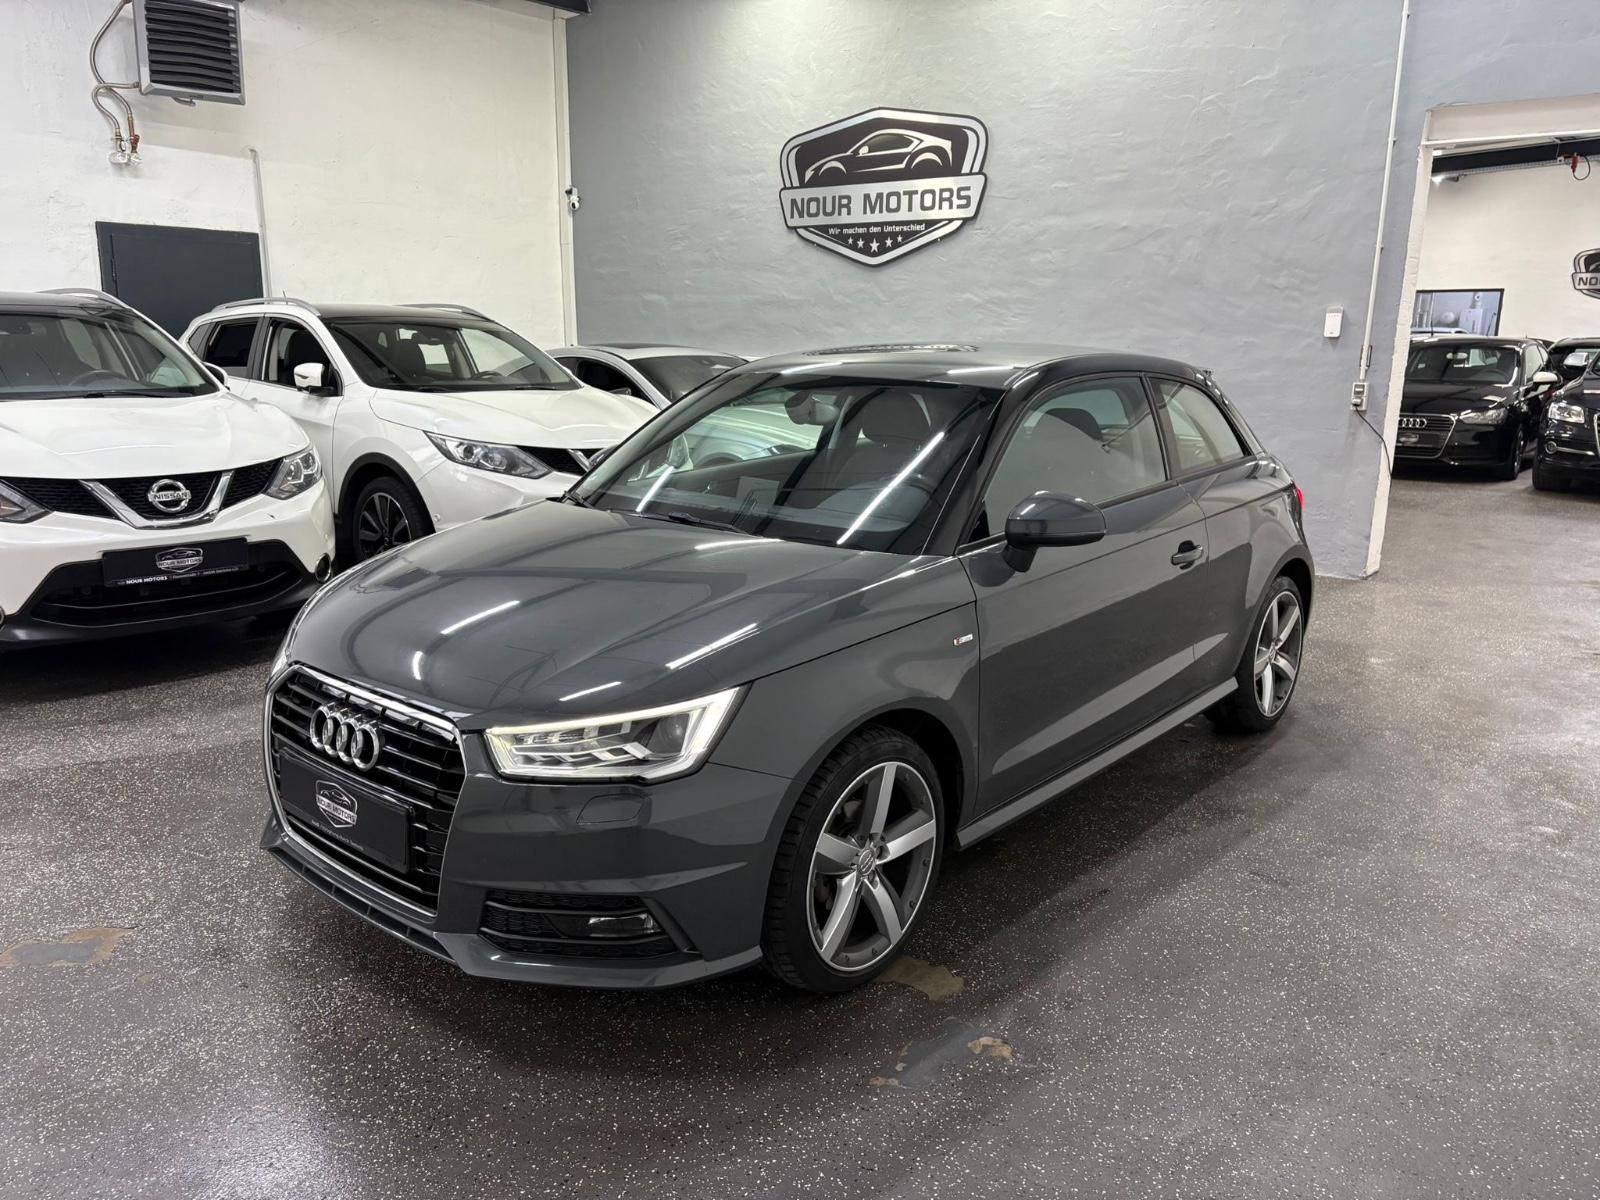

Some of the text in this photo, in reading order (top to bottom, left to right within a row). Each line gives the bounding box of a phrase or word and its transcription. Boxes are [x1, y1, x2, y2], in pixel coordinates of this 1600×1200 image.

[790, 186, 972, 219] NOUR MOTORS
[828, 223, 926, 235] Wir machen den Unterschied
[1578, 277, 1600, 286] NO
[153, 491, 187, 499] NISSAN
